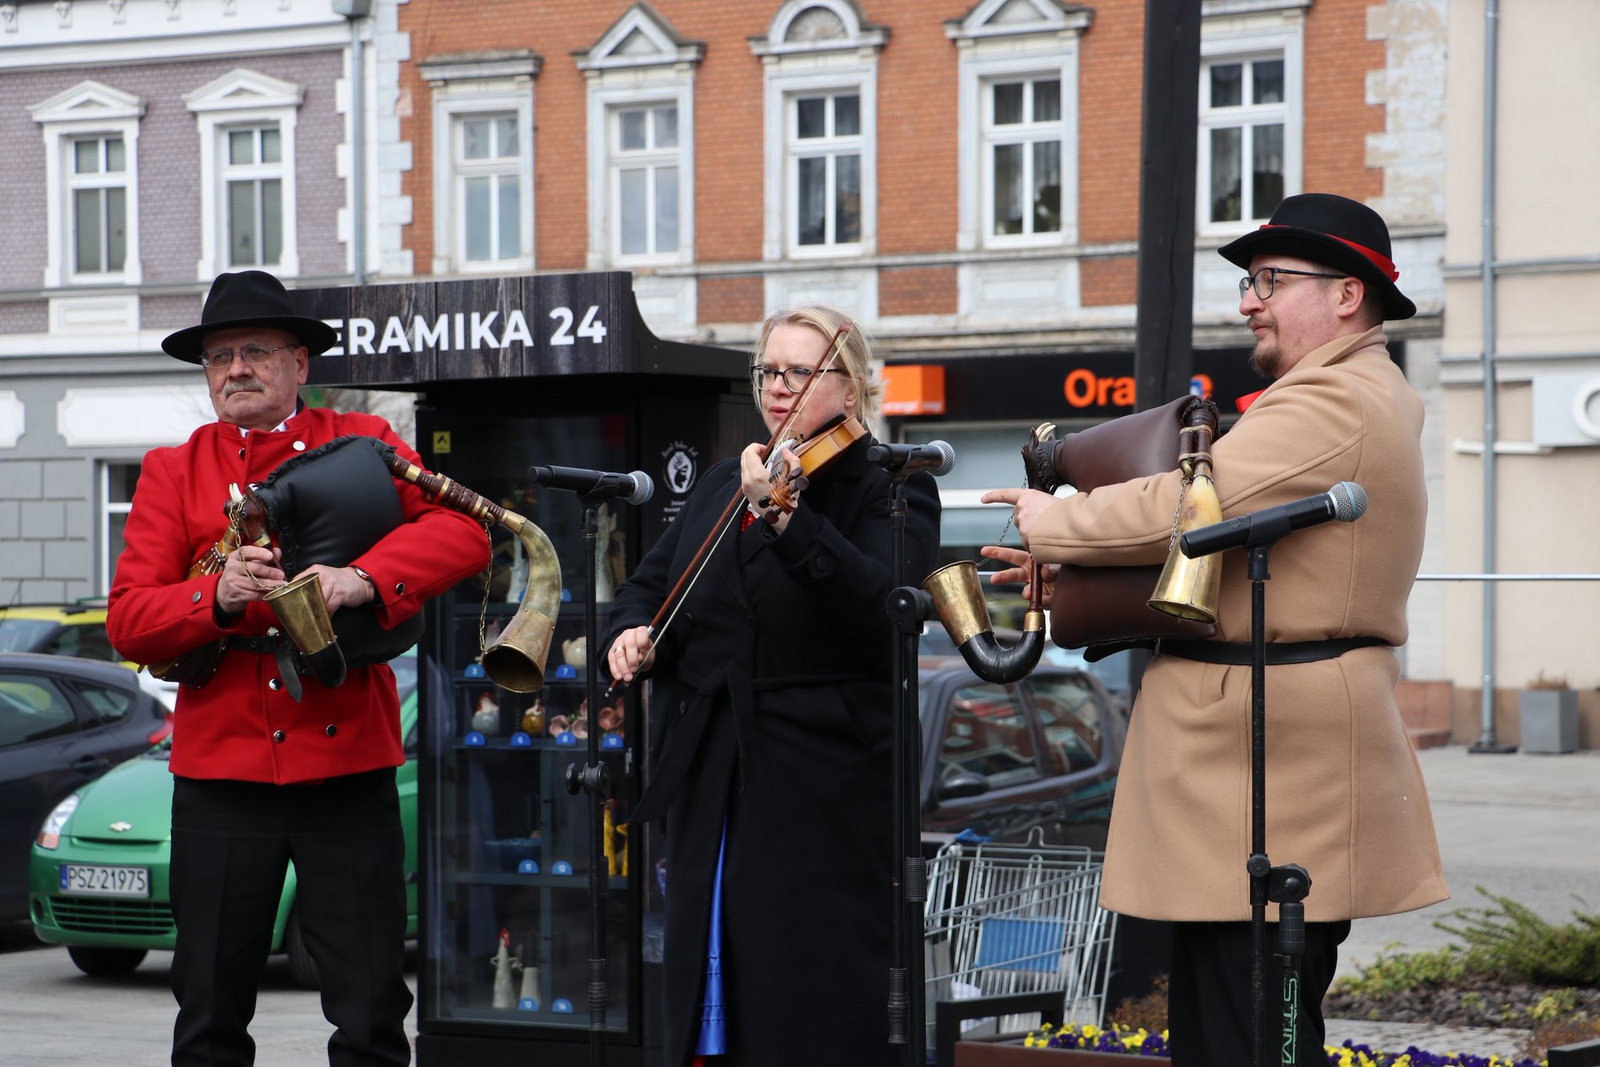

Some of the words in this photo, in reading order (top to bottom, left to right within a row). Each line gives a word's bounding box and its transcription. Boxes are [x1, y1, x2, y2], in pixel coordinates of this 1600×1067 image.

[320, 310, 534, 357] ERAMIKA
[548, 304, 607, 347] 24
[69, 867, 96, 889] PSZ
[101, 869, 146, 891] 21975
